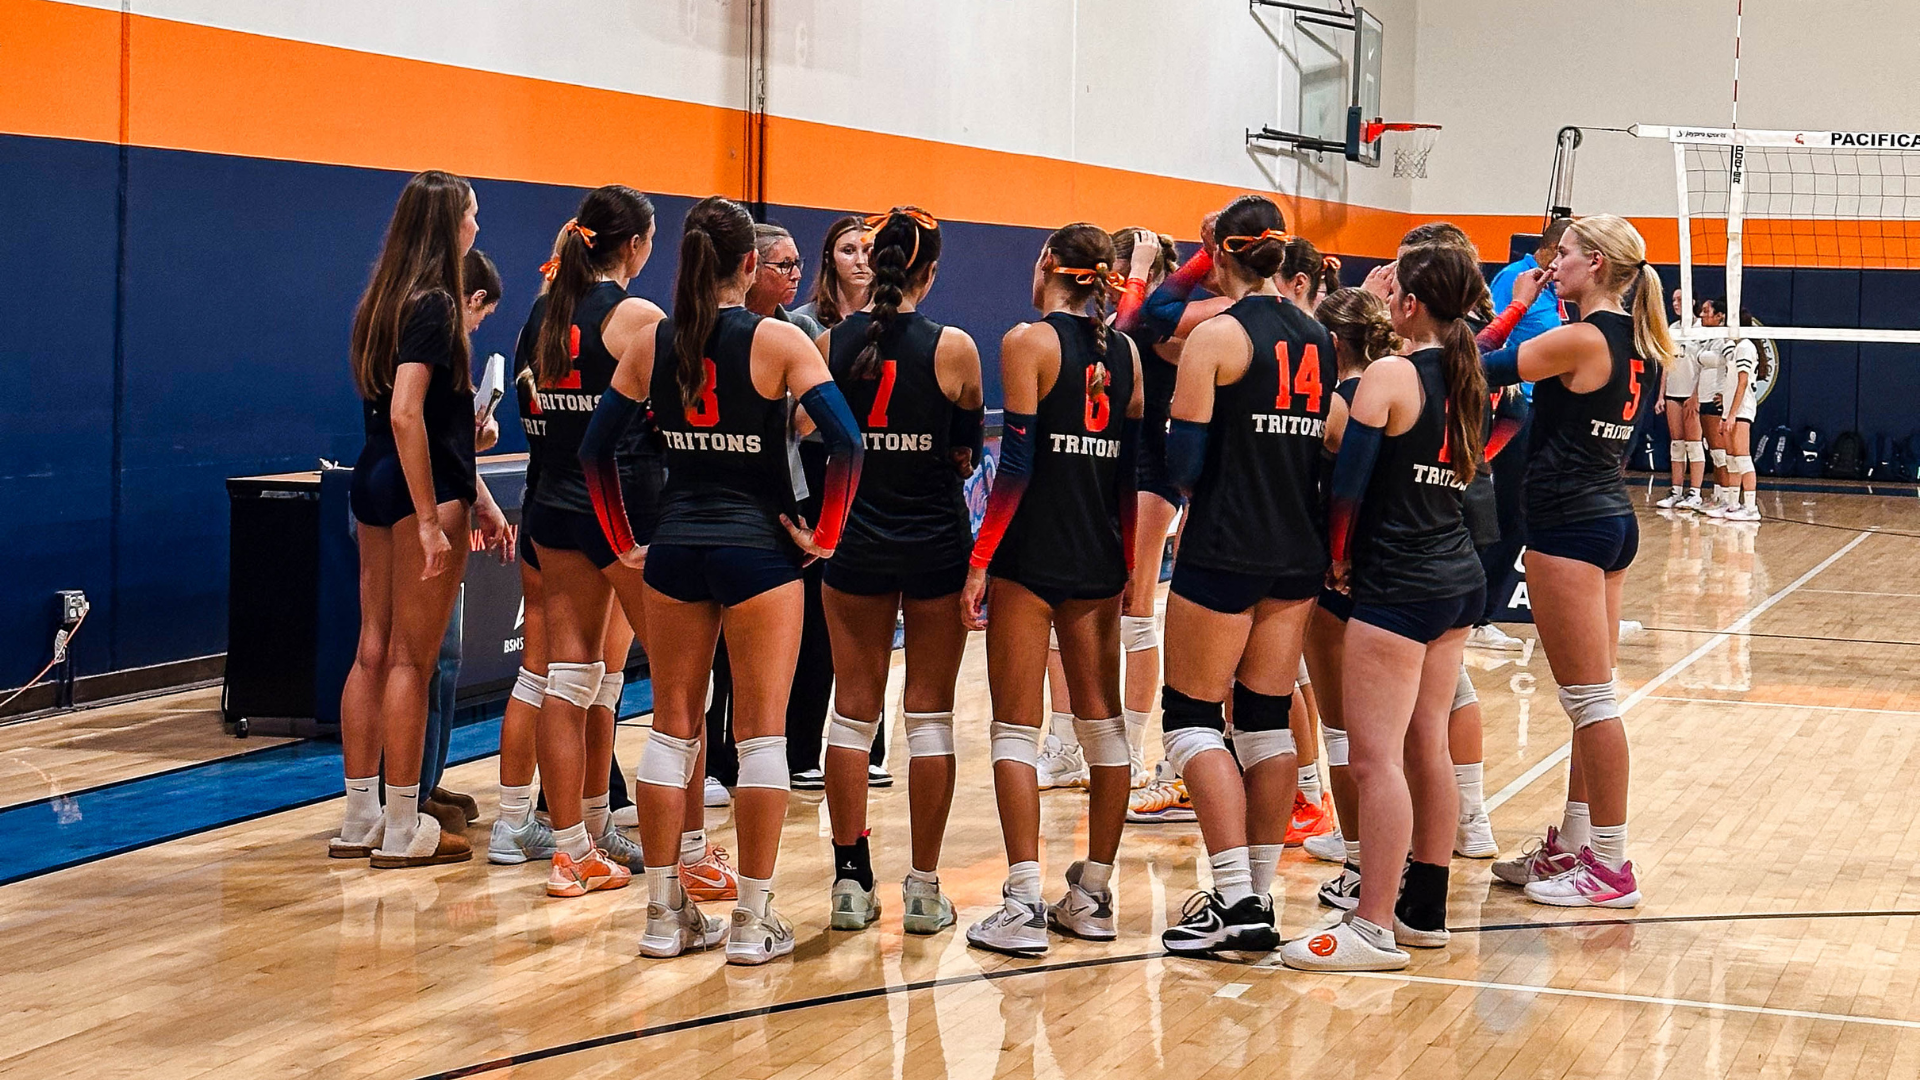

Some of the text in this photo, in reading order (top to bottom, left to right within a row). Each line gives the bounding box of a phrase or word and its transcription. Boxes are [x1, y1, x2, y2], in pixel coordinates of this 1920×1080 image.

[1831, 132, 1920, 148] PACIFICA
[861, 360, 897, 427] 7
[1085, 363, 1111, 432] 6
[1275, 340, 1323, 413] 14
[1623, 359, 1645, 421] 5
[662, 430, 762, 453] TRITONS
[860, 432, 933, 451] ITONS
[1050, 433, 1121, 458] TRITON
